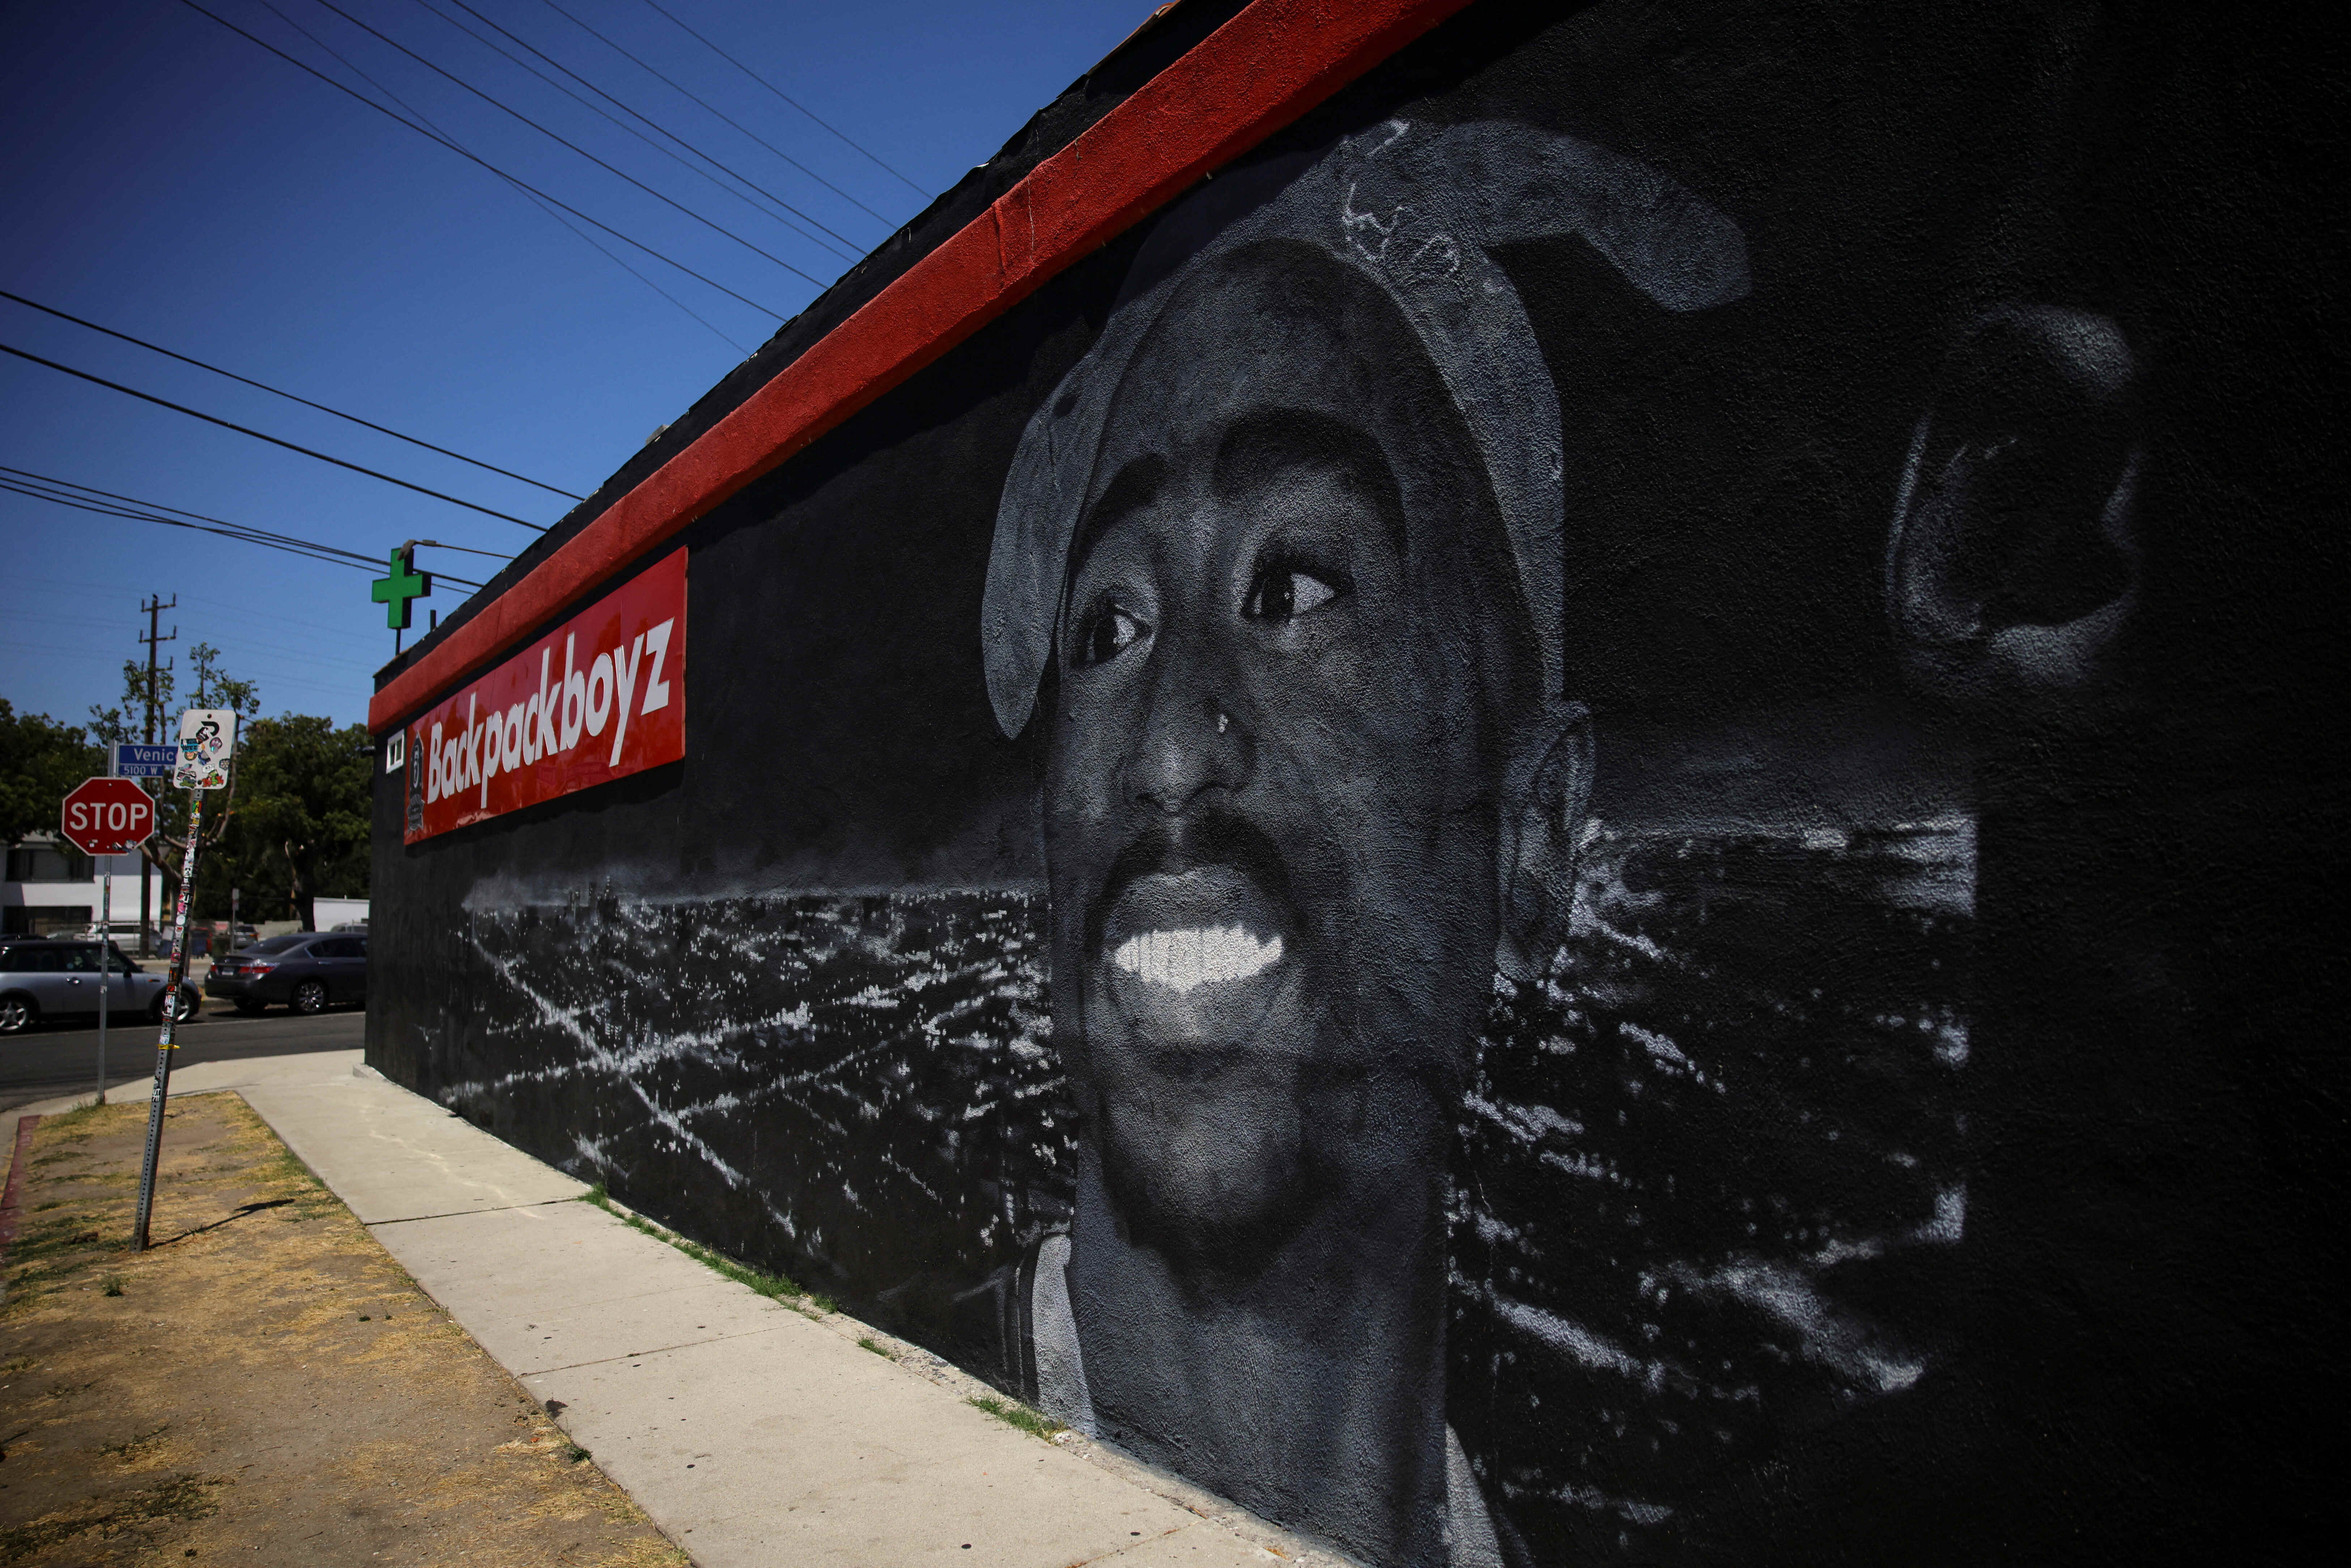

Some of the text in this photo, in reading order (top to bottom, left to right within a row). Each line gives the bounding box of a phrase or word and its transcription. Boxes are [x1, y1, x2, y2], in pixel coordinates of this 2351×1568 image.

[427, 616, 675, 809] Backpackboyz
[133, 748, 178, 761] Venic
[124, 765, 158, 775] 5100 W
[69, 802, 148, 831] STOP
